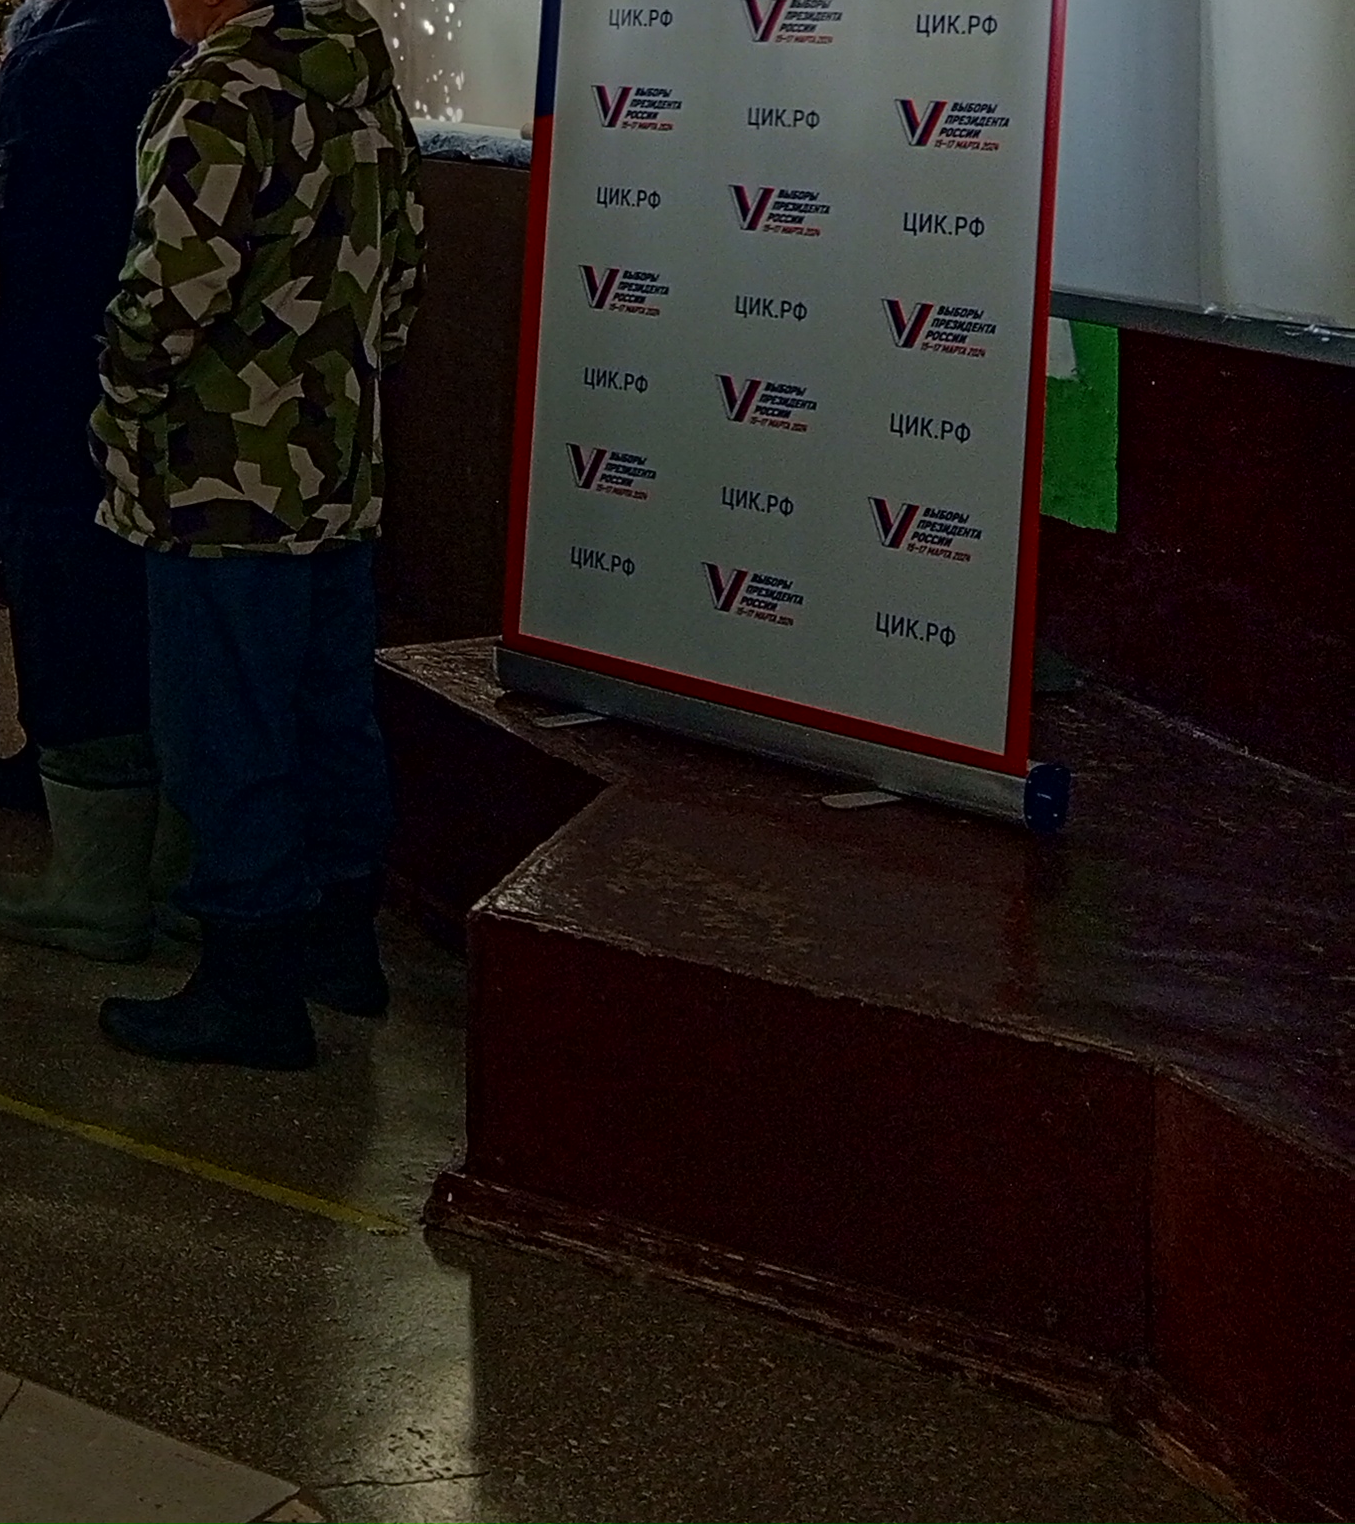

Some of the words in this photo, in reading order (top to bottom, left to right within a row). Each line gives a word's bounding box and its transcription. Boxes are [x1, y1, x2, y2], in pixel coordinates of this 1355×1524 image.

[607, 8, 673, 29] ЦИК.РФ
[916, 14, 997, 37] ЦИК.РФ
[747, 107, 819, 129] ЦИК.РФ
[951, 102, 997, 113] ВЫБОРЫ
[939, 127, 981, 139] РОССИИ
[945, 115, 1009, 129] ПРЕЗИДЕНТА
[595, 186, 661, 208] ЦИК.РФ
[903, 212, 984, 237] ЦИК.РФ
[734, 295, 807, 321] ЦИК.РФ
[937, 305, 983, 319] ВЫБОРЫ
[925, 330, 967, 344] РОССИИ
[931, 317, 995, 335] ПРЕЗИДЕНТА
[583, 367, 648, 393] ЦИК.РФ
[889, 412, 970, 442] ЦИК.РФ
[721, 486, 793, 516] ЦИК.РФ
[923, 507, 969, 524] ВЫБОРЫ
[911, 531, 953, 547] РОССИИ
[917, 519, 981, 541] ПРЕЗИДЕНТА
[570, 546, 635, 575] ЦИК.РФ
[875, 611, 955, 646] ЦИК.РФ
